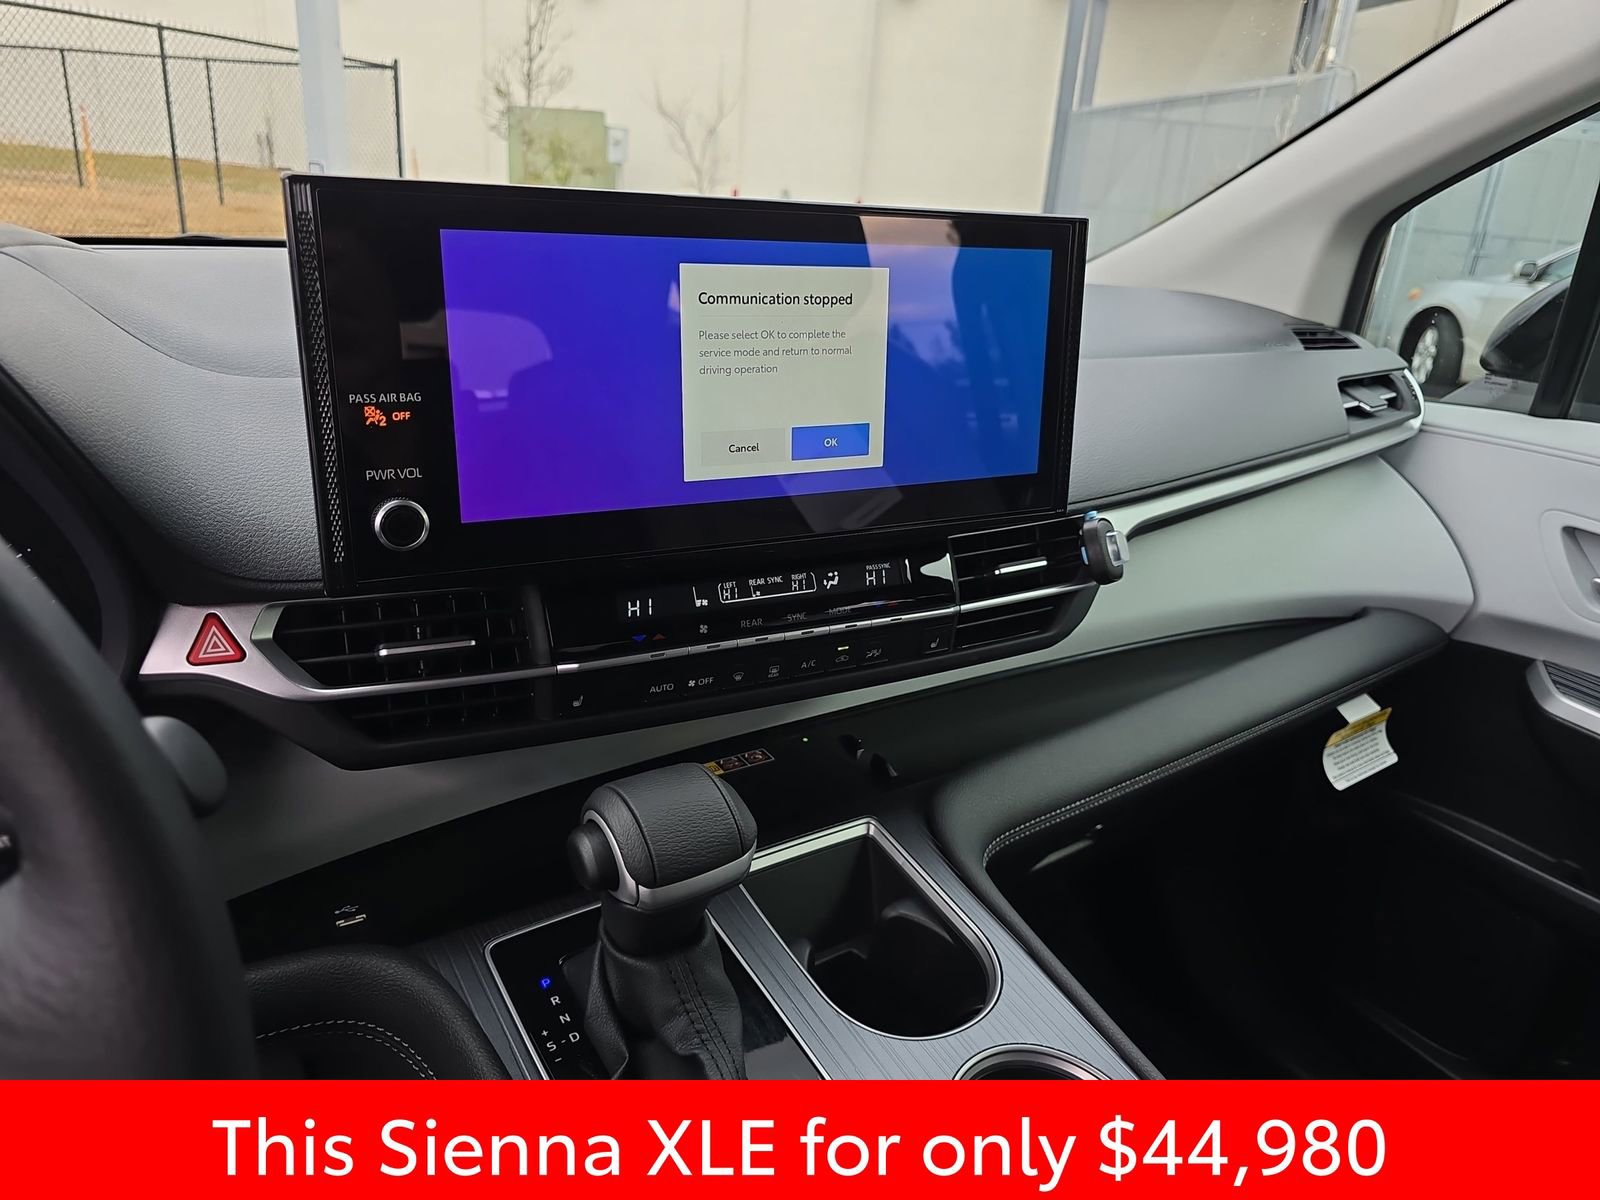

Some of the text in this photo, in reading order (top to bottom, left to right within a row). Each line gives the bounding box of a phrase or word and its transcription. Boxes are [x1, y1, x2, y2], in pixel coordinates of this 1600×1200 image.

[698, 291, 853, 308] Communication stopped
[698, 329, 846, 341] Please select OK to complete the
[699, 345, 852, 358] service mode and return to normal
[699, 364, 778, 377] driving operation
[348, 391, 422, 404] PASS AIR BAG
[392, 411, 411, 421] OFF
[728, 443, 760, 454] Cancel
[823, 437, 838, 448] OK
[365, 467, 423, 481] PWR VOL
[748, 575, 784, 587] REAR SYNC
[865, 569, 886, 587] HI
[723, 581, 736, 589] LEFT
[791, 579, 806, 592] HI
[722, 587, 738, 600] HI
[627, 597, 654, 618] HI
[786, 611, 808, 622] SYNC
[740, 618, 764, 629] REAR
[801, 659, 817, 669] A/C
[697, 676, 715, 686] OFF
[649, 682, 675, 694] AUTO
[541, 978, 550, 988] P
[550, 996, 561, 1006] R
[559, 1013, 571, 1024] N
[546, 1031, 580, 1052] S D
